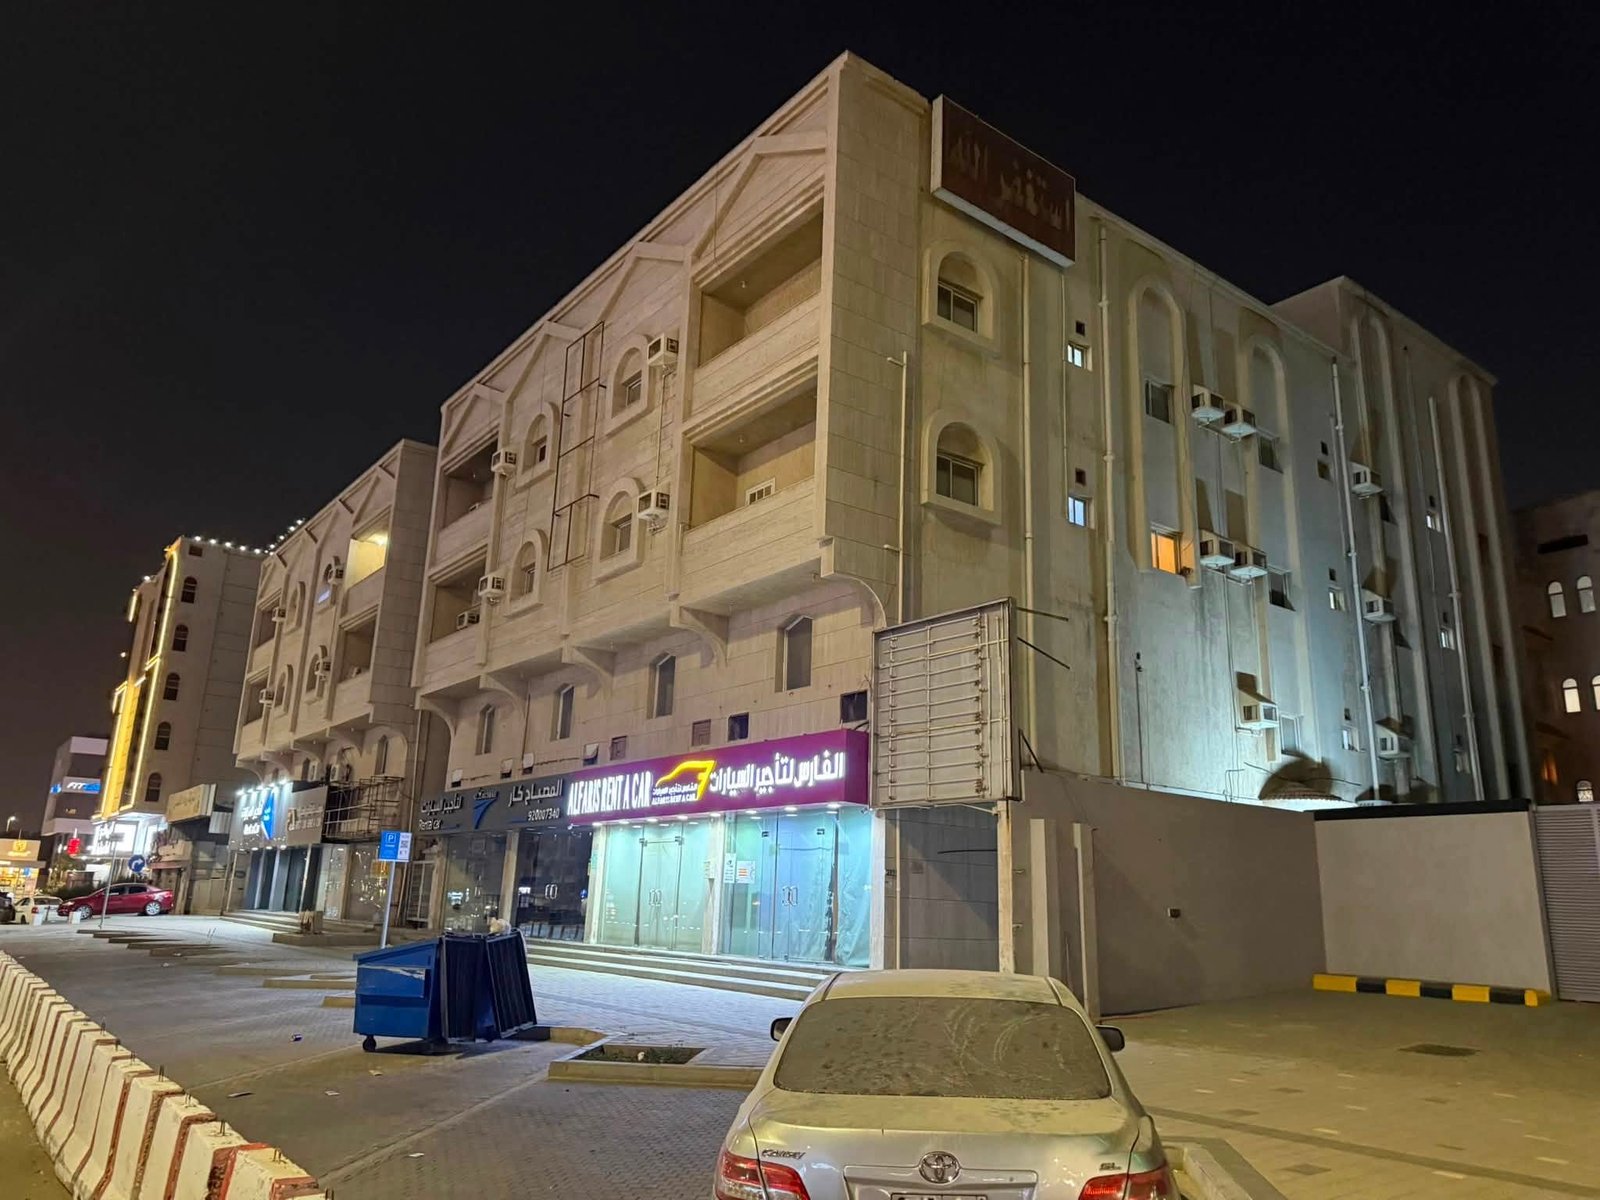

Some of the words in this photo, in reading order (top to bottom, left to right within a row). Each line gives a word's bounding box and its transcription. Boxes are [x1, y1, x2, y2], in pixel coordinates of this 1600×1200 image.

[709, 763, 755, 797] السيارات
[754, 752, 795, 795] لتأجير
[793, 750, 845, 788] الفارس
[508, 784, 524, 807] كار
[525, 779, 564, 806] المصباح
[567, 779, 601, 816] ALFARIS
[601, 775, 624, 812] RENT
[623, 774, 630, 810] A
[632, 770, 653, 809] CAR
